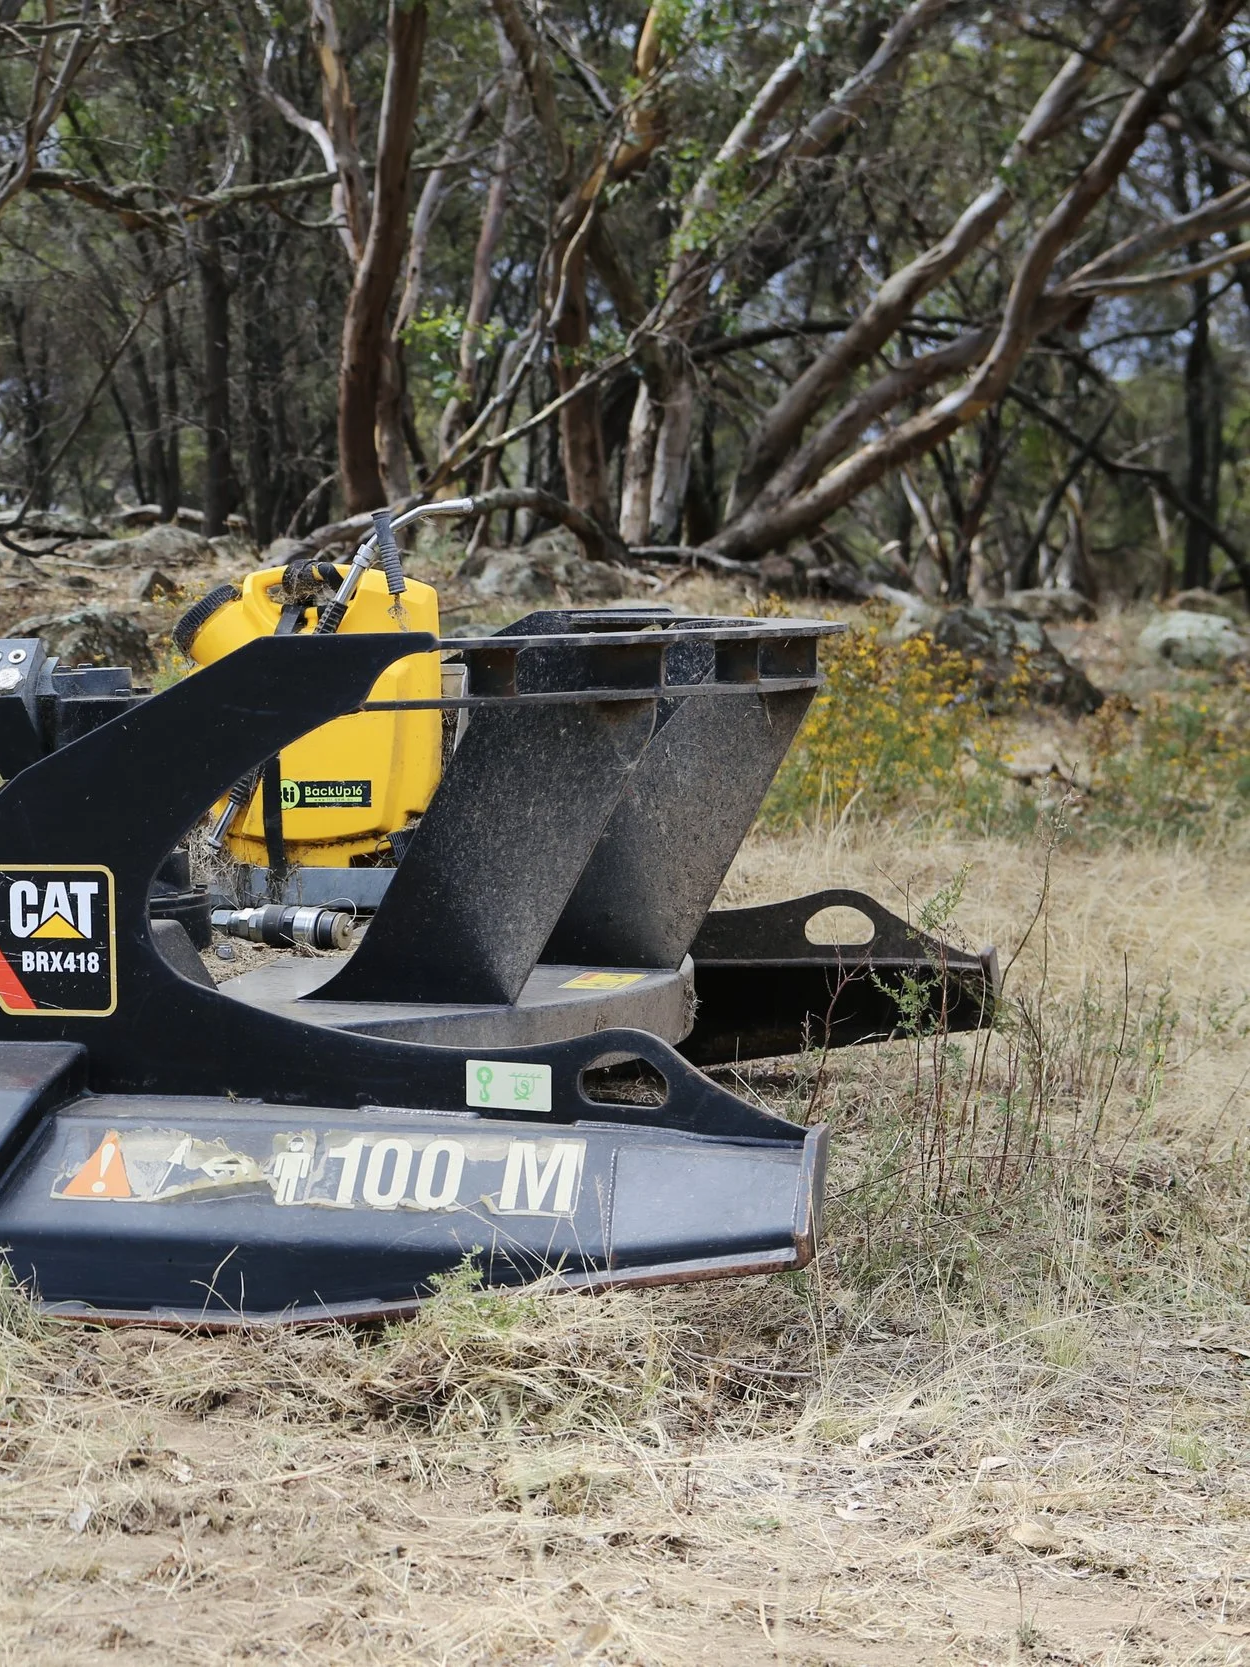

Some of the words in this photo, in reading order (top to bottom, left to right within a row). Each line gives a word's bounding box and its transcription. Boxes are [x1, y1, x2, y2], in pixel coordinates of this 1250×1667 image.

[304, 786, 362, 798] BackUp16
[9, 880, 98, 939] CAT
[21, 951, 100, 973] BRX418
[328, 1137, 465, 1208] 100
[499, 1142, 580, 1212] M
